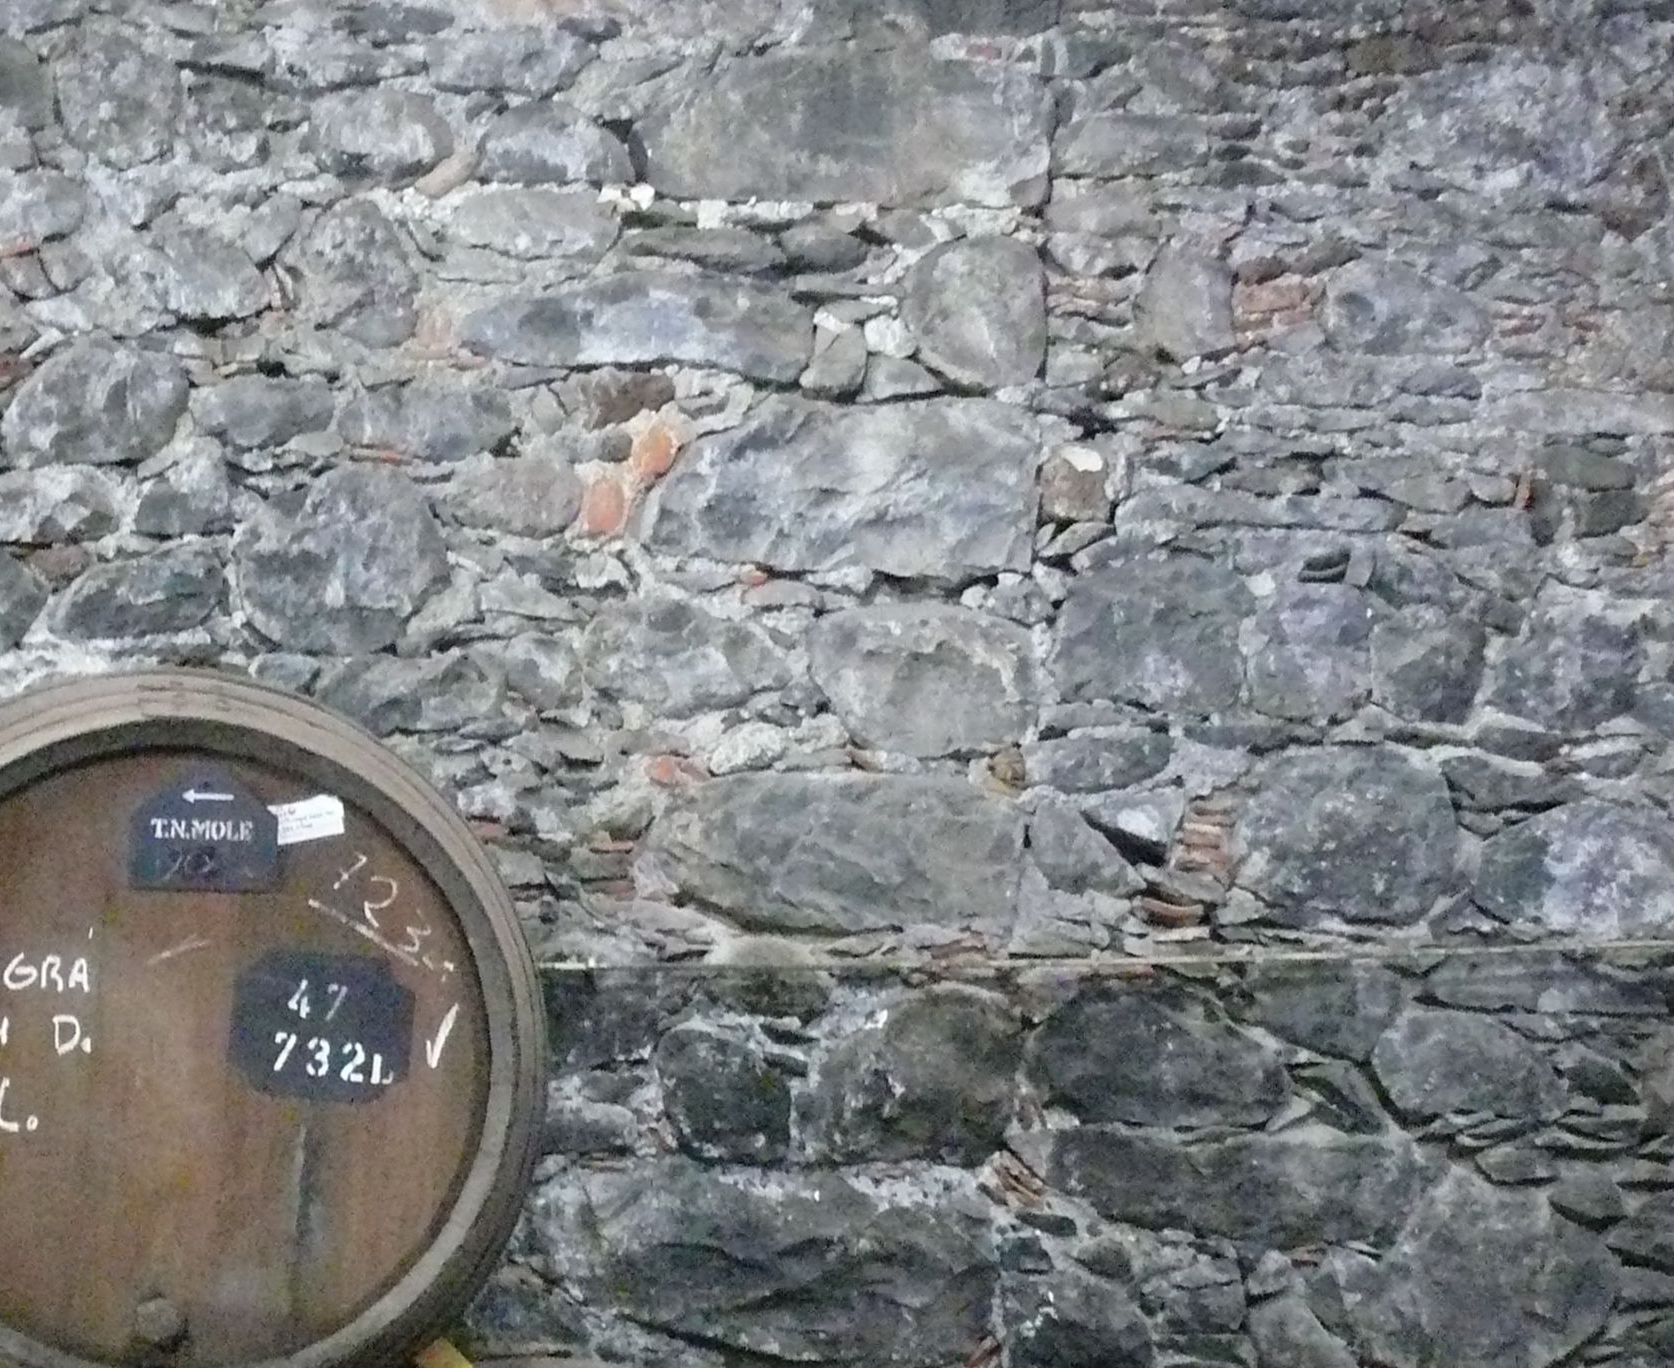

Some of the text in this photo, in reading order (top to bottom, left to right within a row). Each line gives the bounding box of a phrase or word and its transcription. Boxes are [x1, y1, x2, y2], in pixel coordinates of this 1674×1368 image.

[150, 817, 254, 842] T.N.MOLE
[287, 979, 348, 1022] 47
[52, 1014, 92, 1056] D.
[273, 1032, 395, 1086] 732L
